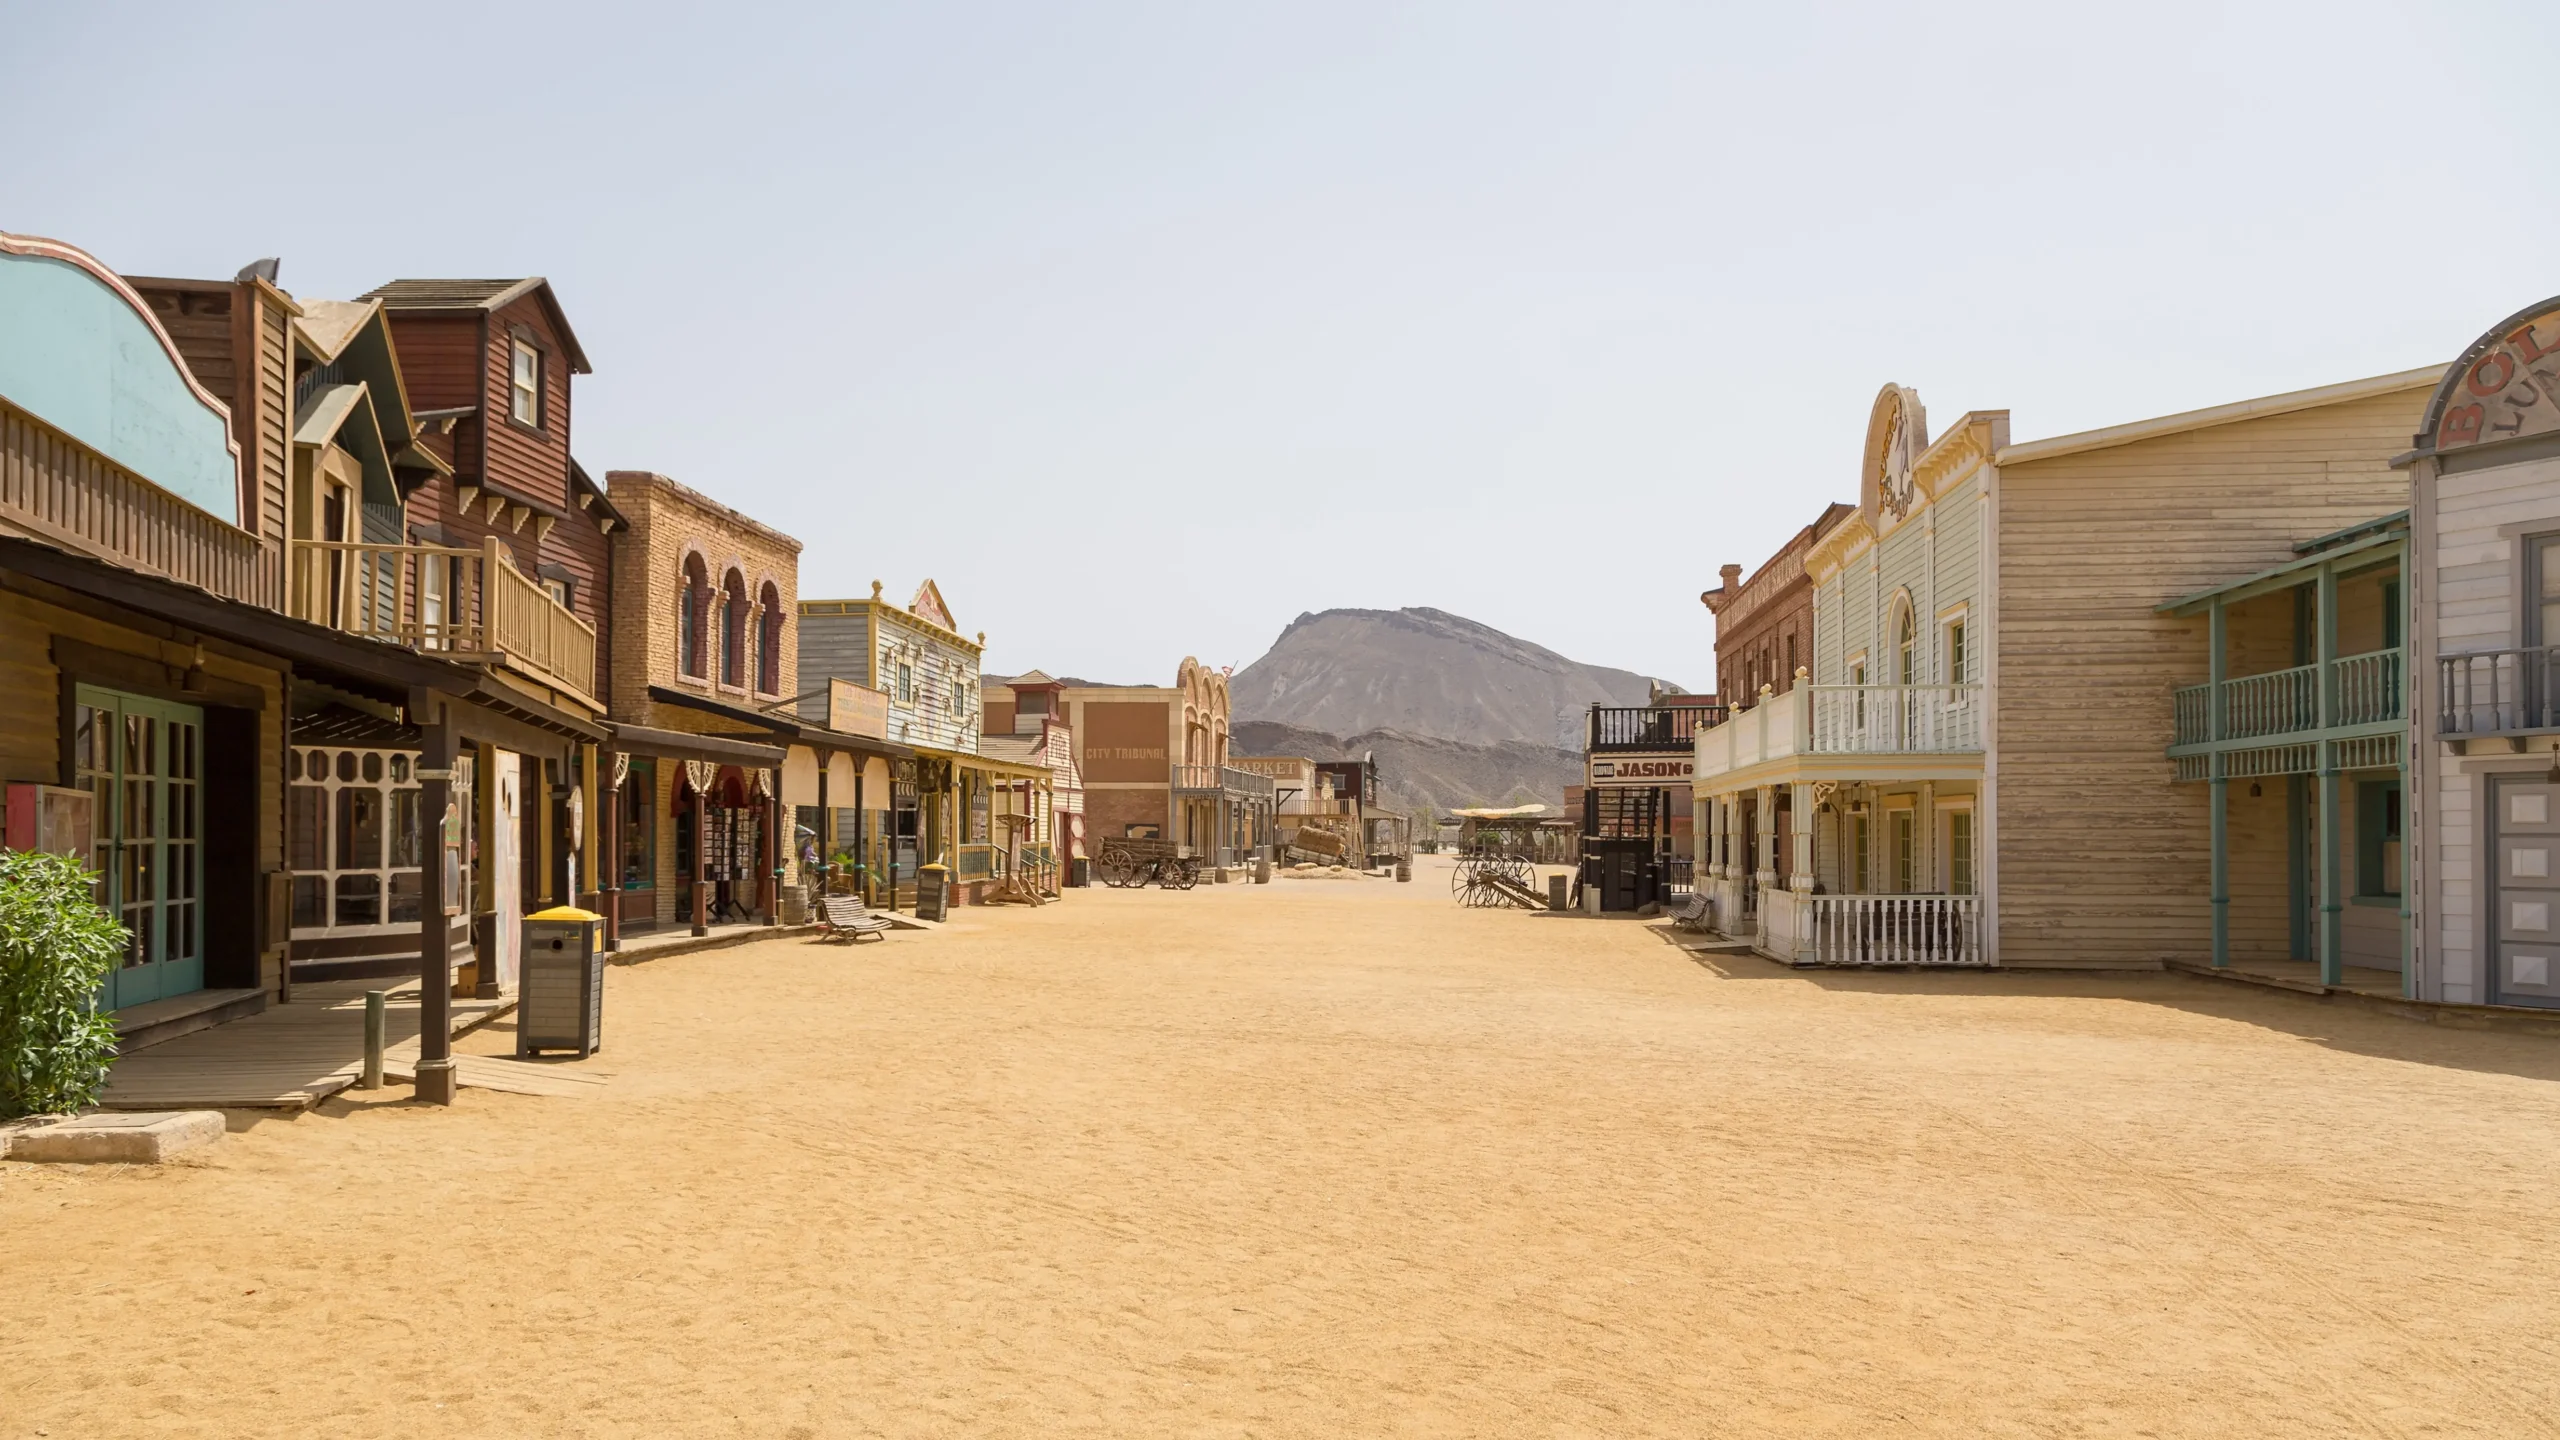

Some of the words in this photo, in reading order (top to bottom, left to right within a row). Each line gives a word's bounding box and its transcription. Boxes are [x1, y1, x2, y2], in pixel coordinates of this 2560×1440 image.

[1771, 546, 1801, 594] SALOON
[1086, 748, 1111, 760] CITY
[1114, 747, 1167, 760] TRIBUNAL
[1617, 762, 1682, 777] JASON
[1683, 764, 1693, 775] &
